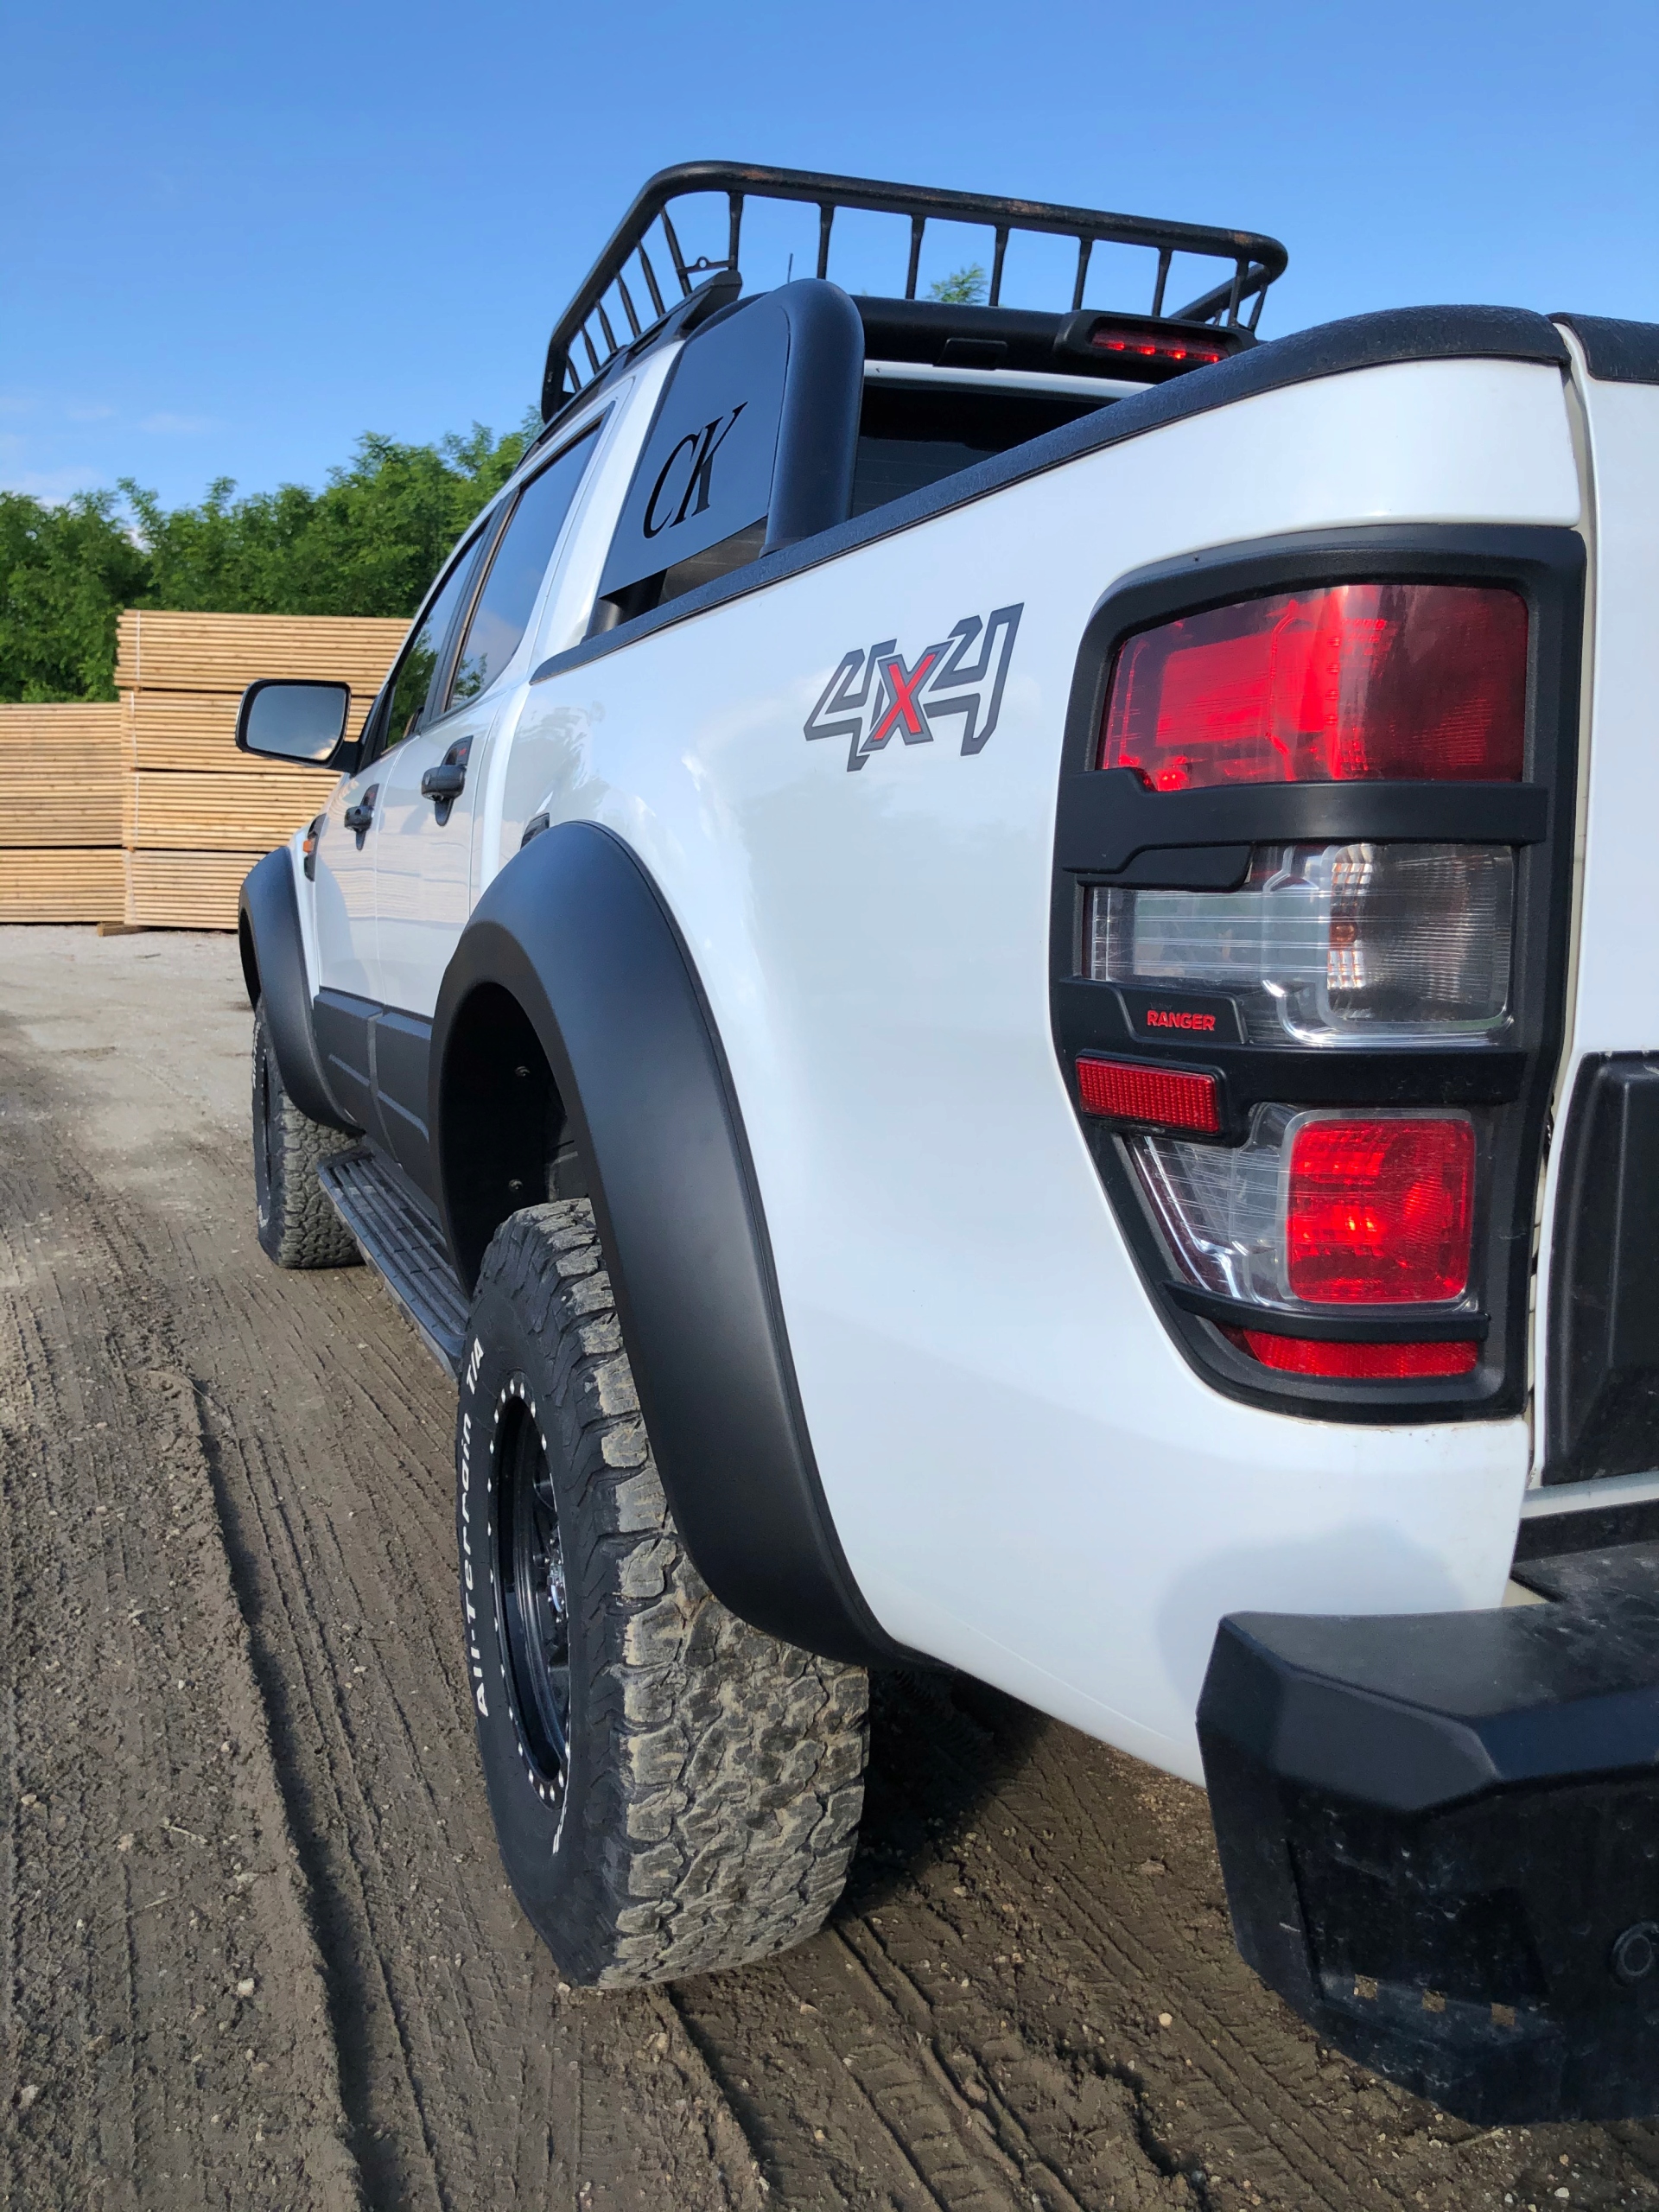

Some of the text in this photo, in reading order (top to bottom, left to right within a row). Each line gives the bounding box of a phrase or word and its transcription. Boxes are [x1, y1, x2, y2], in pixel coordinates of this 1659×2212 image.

[643, 401, 748, 538] CK
[1147, 1009, 1217, 1031] RANGER
[461, 1338, 489, 1717] All-Terrain T/A
